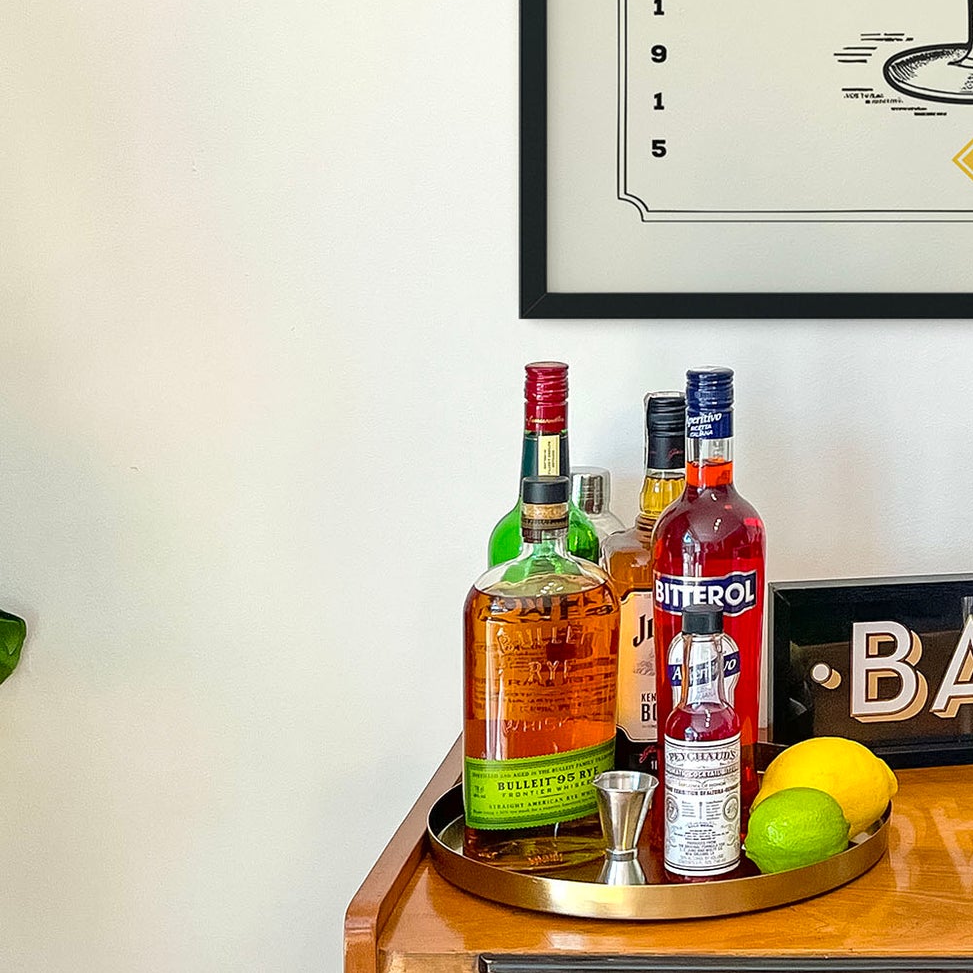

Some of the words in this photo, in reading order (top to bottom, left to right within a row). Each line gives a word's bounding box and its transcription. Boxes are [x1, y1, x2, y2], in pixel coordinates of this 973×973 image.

[655, 579, 755, 607] BITTEROL
[497, 777, 553, 791] BULLEIT
[557, 772, 576, 785] 95
[579, 766, 600, 779] RYE
[502, 786, 552, 798] FRONTIER
[556, 779, 592, 792] WHISKE
